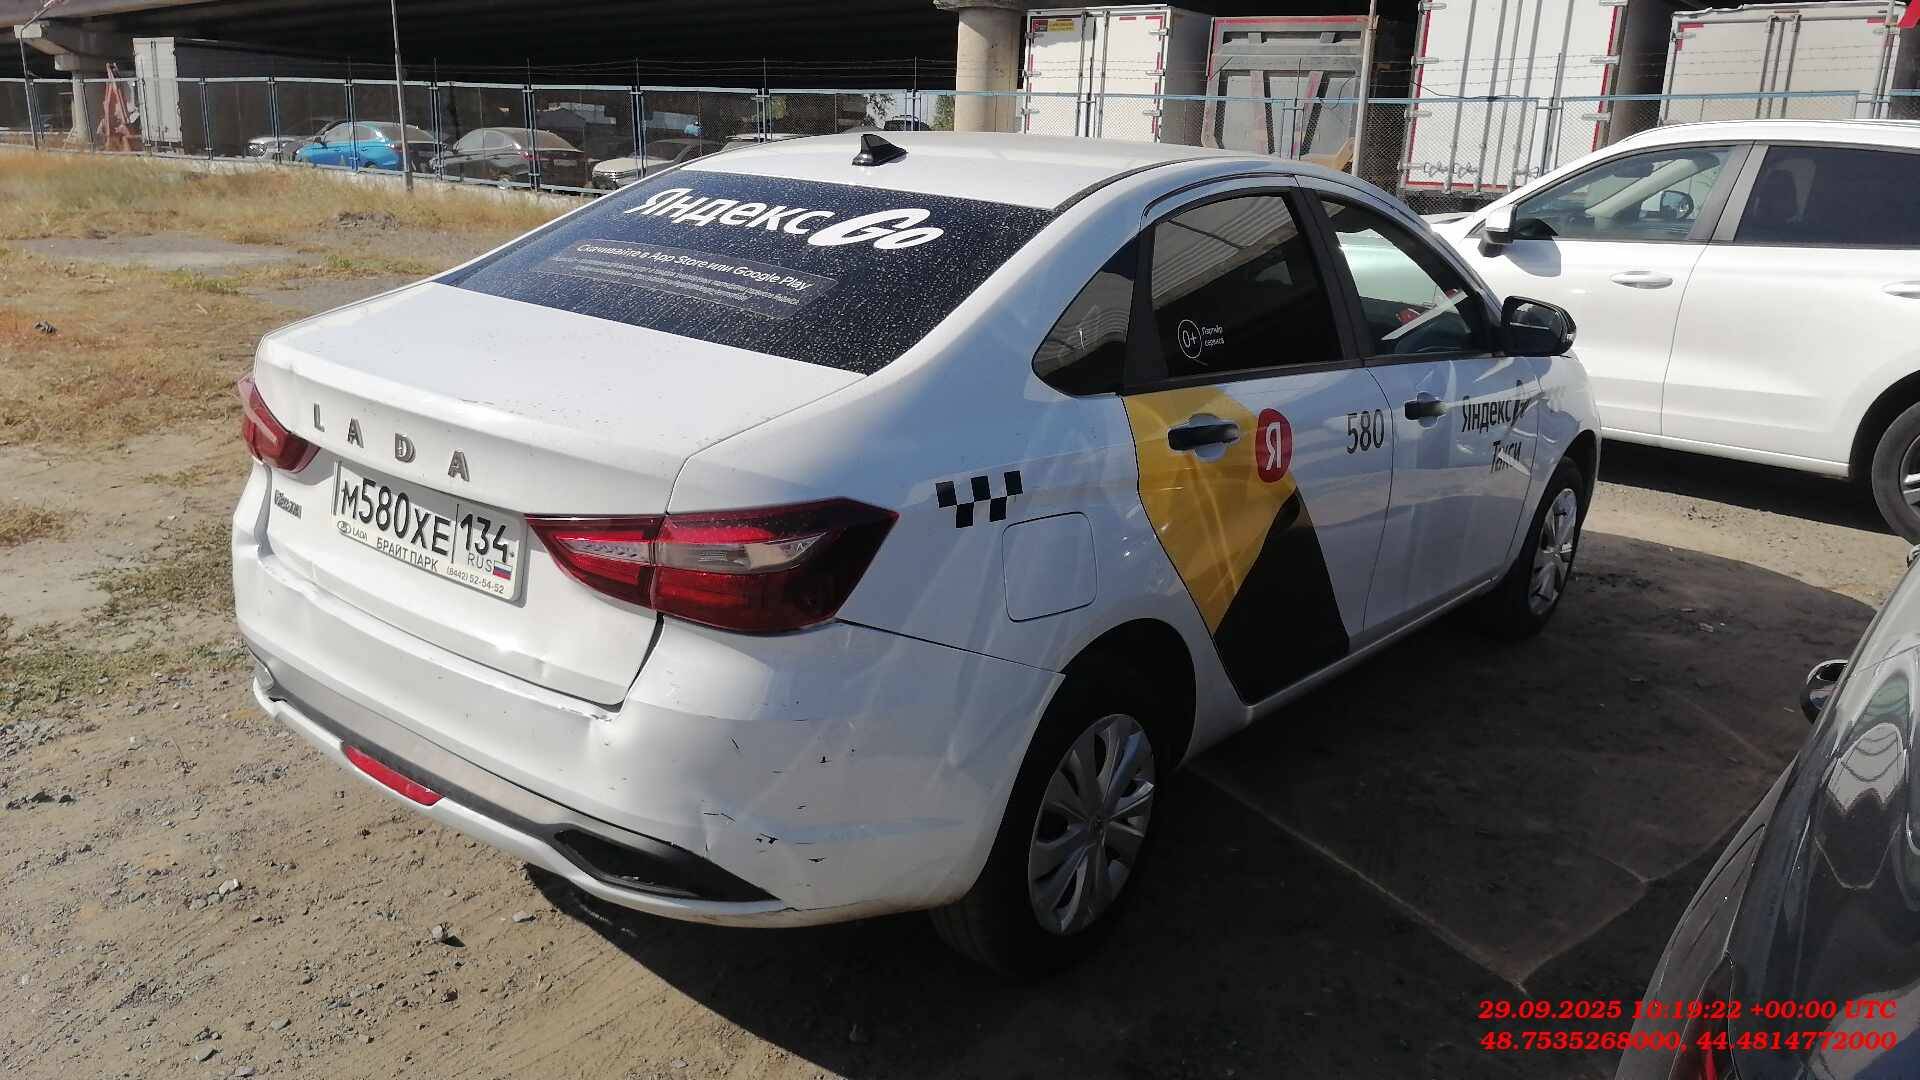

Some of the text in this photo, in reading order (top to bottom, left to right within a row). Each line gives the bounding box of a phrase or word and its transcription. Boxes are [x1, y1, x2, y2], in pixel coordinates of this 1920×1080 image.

[623, 187, 945, 250] Яндекс Go
[647, 252, 676, 264] App
[674, 255, 709, 268] Store
[706, 261, 735, 273] или
[732, 266, 781, 283] Google
[778, 275, 813, 292] Play
[313, 402, 471, 482] LADA
[1264, 420, 1283, 471] Я
[1346, 409, 1385, 454] 580
[352, 527, 368, 541] LADA
[410, 550, 440, 573] ПАРК
[469, 574, 505, 594] 52-54-52
[460, 513, 508, 563] 134
[467, 552, 493, 573] RUS
